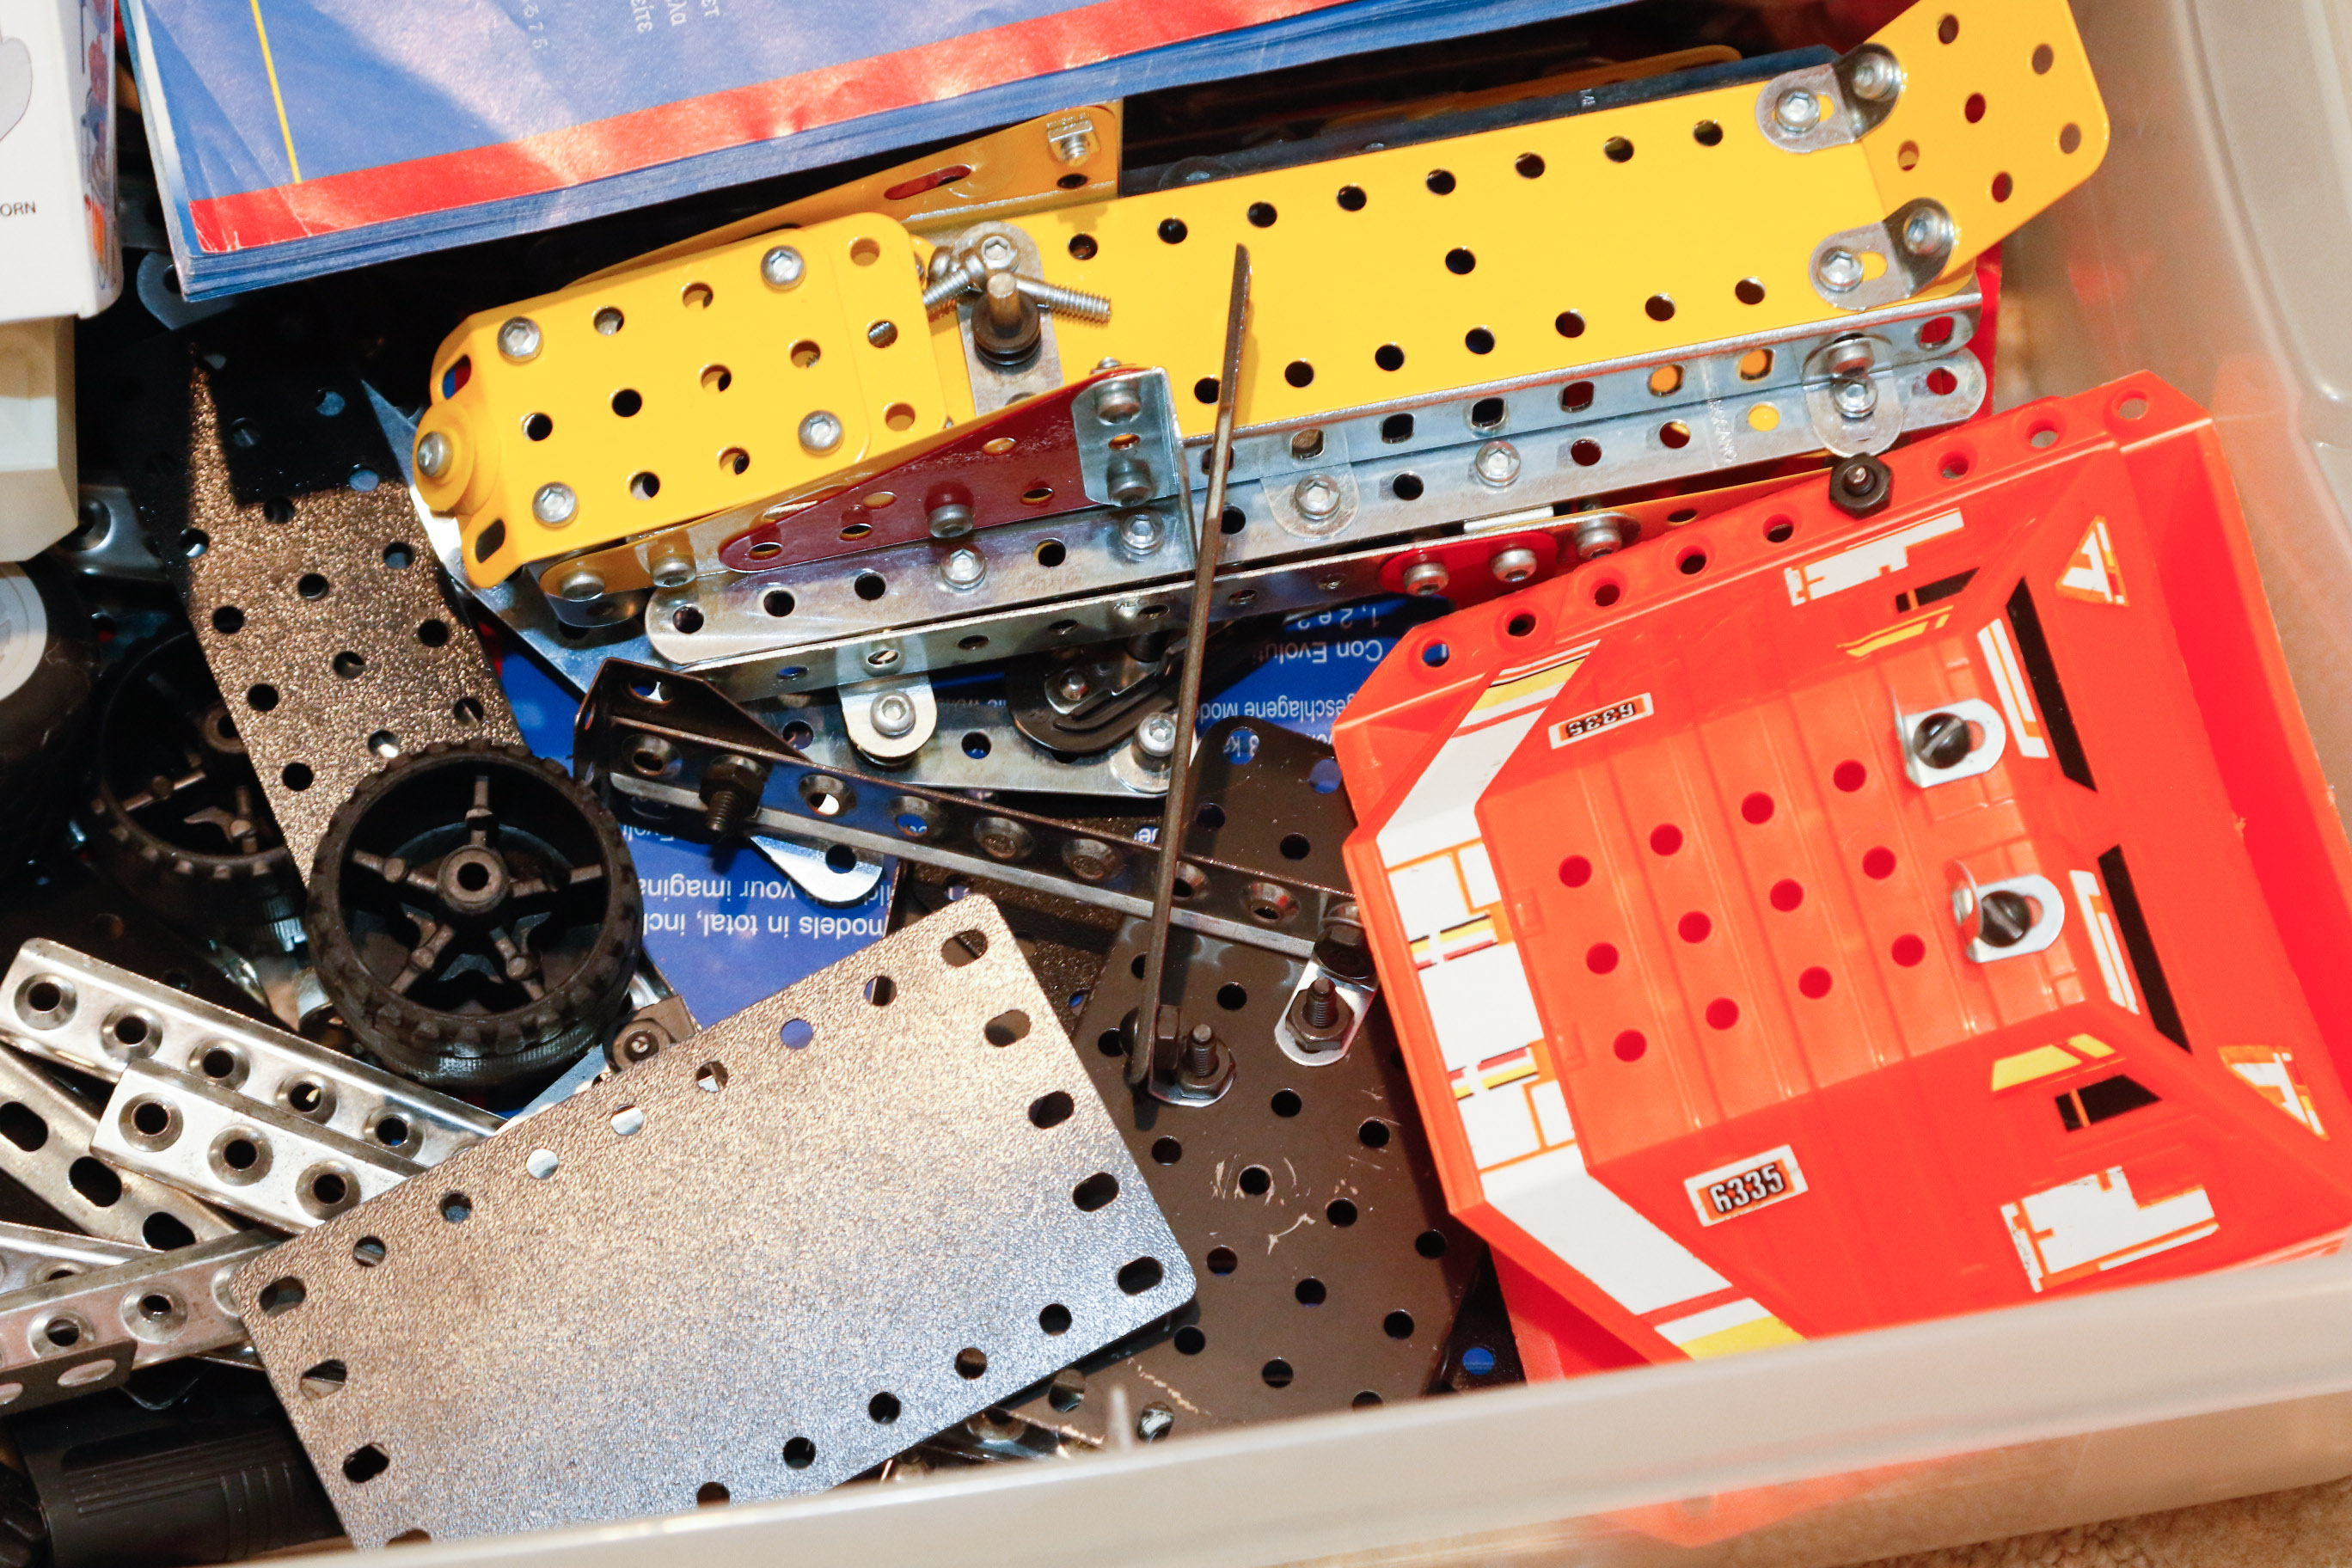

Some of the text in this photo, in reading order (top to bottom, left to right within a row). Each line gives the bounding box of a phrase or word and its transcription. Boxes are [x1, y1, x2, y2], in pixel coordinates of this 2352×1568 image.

[1336, 639, 1383, 662] Con
[1197, 700, 1239, 725] Mod
[740, 879, 796, 899] your
[696, 910, 758, 937] total,
[768, 916, 789, 939] in
[1709, 1162, 1785, 1213] 6335
